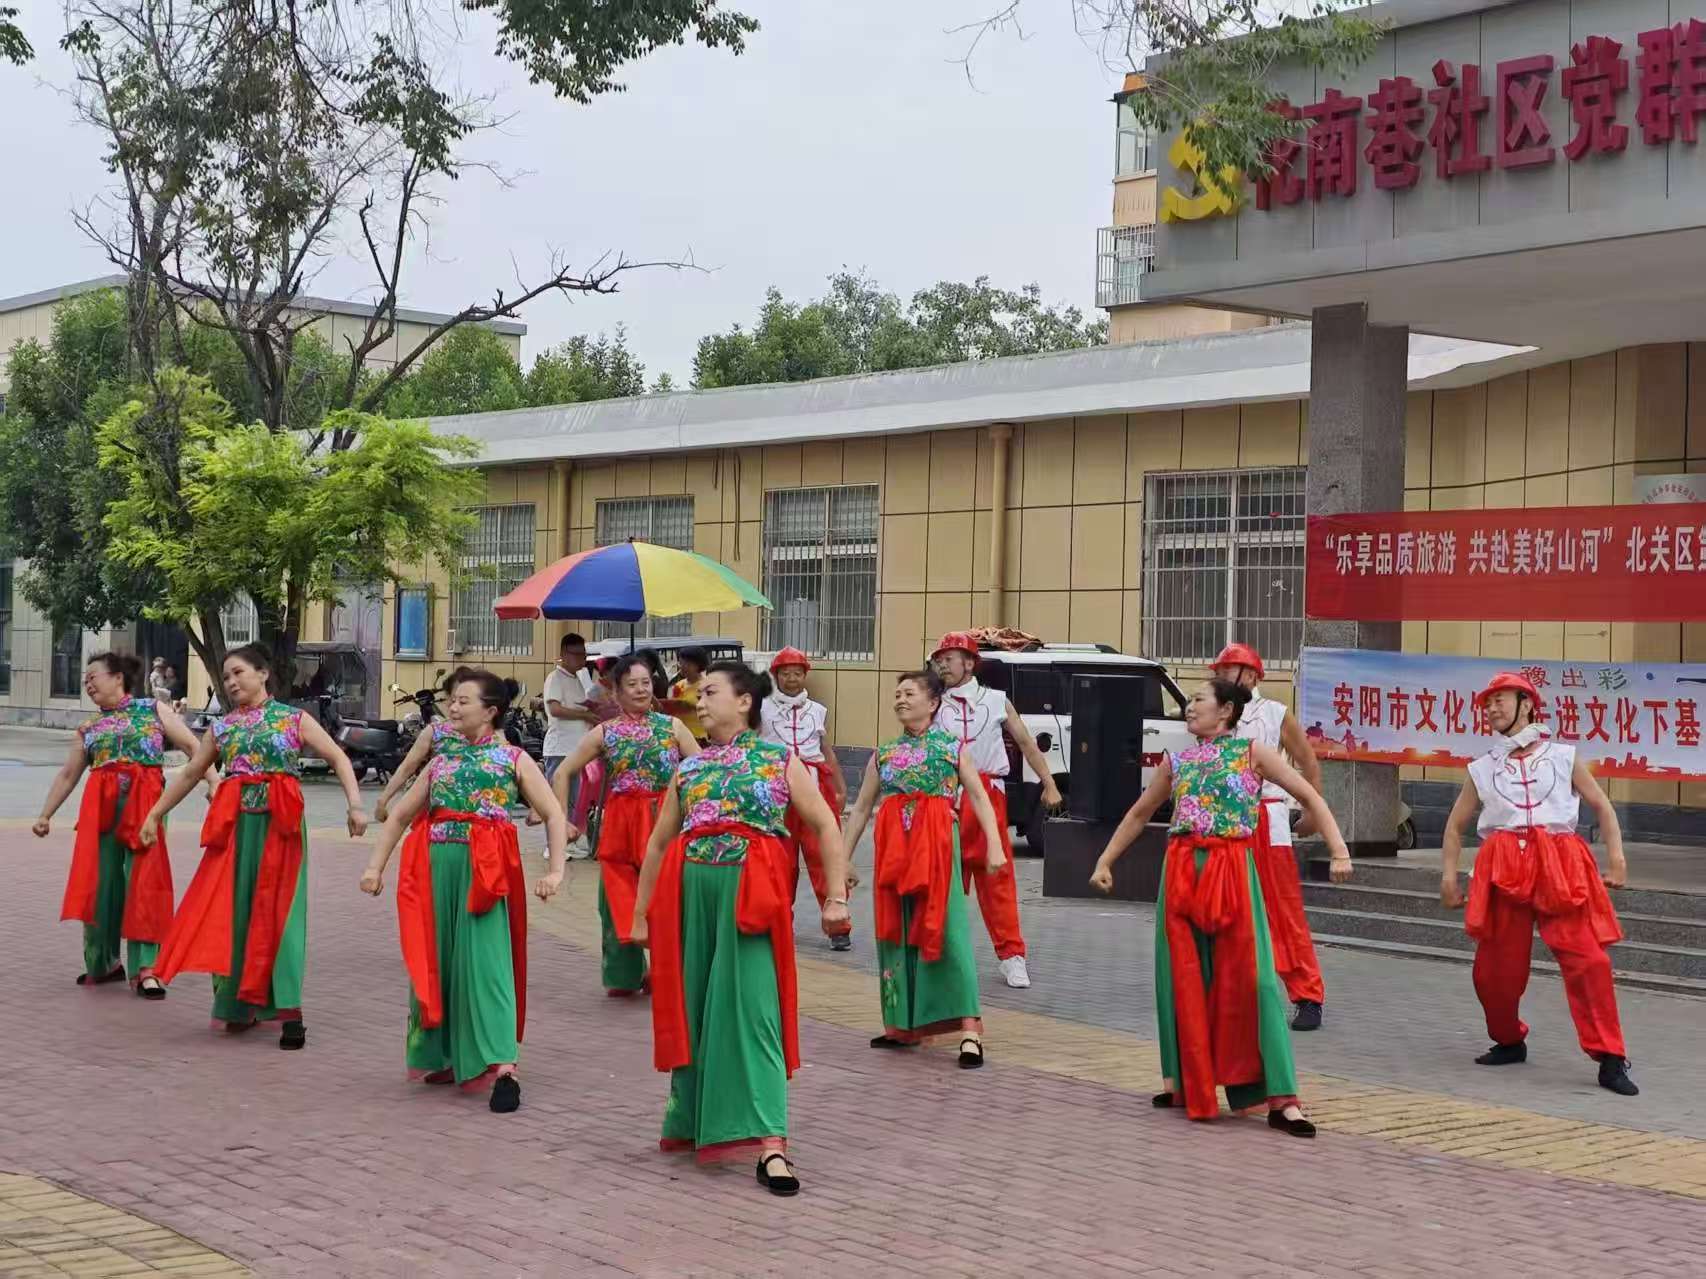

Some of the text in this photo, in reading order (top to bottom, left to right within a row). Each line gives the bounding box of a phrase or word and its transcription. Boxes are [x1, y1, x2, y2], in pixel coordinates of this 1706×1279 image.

[1325, 531, 1457, 577] “乐享品质旅游
[1469, 527, 1613, 575] 共赴美好山河”
